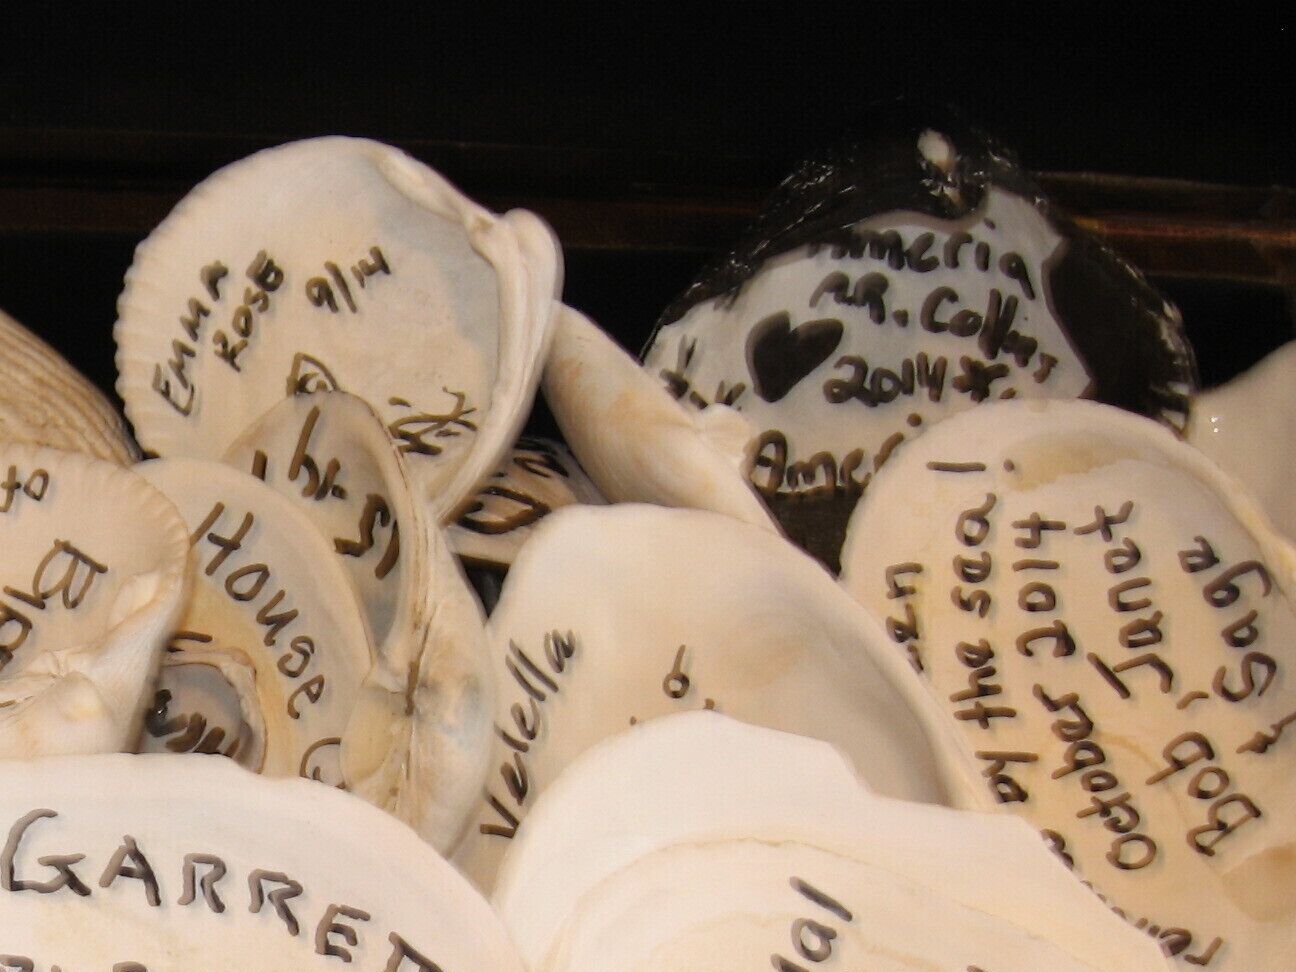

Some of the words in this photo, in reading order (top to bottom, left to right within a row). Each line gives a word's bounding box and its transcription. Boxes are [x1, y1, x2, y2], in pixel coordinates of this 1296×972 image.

[152, 260, 228, 416] EMMA
[212, 249, 284, 371] ROSE
[306, 246, 391, 313] 9/14
[189, 501, 325, 719] House
[1011, 512, 1076, 660] 2014
[1074, 500, 1173, 699] Janet
[1177, 535, 1277, 703] Sage
[950, 638, 1017, 730] the
[1032, 683, 1157, 870] October
